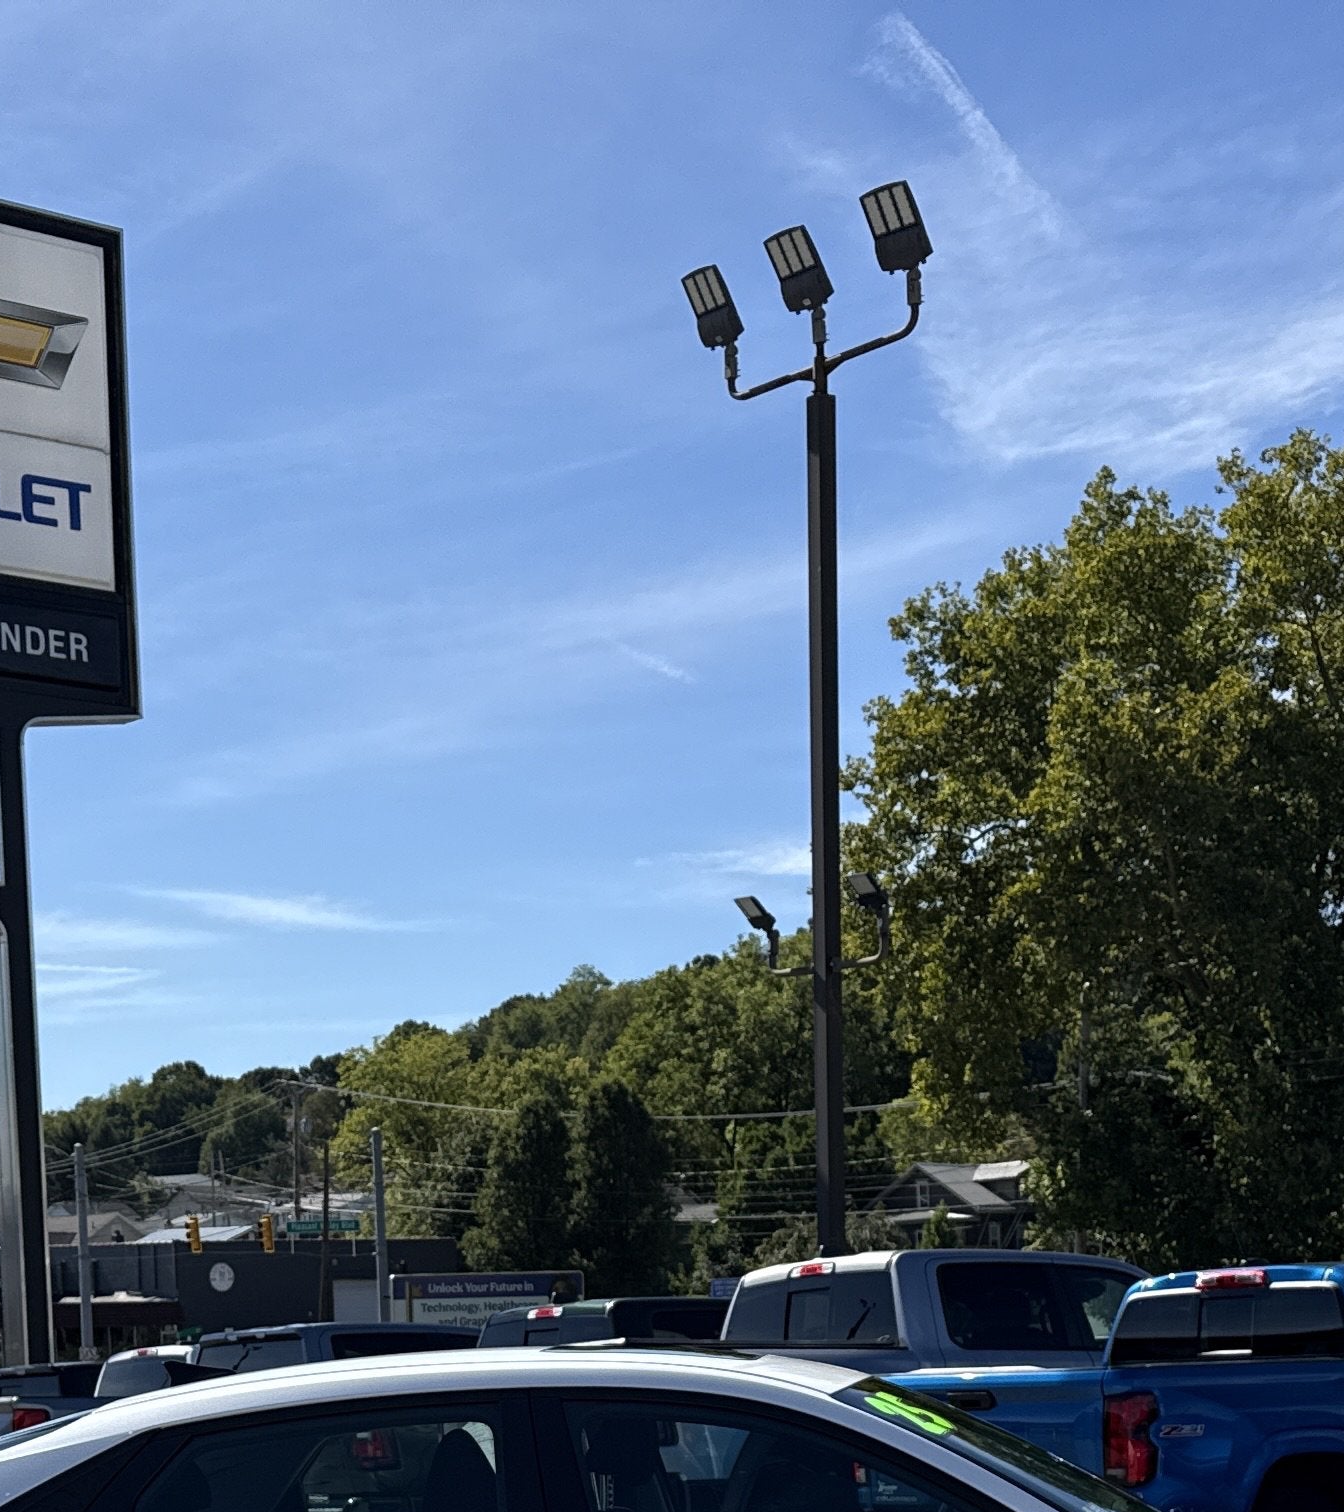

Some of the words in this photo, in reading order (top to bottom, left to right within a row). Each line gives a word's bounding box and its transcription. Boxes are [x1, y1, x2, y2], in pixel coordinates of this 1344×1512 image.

[428, 1282, 463, 1294] Unlock
[465, 1282, 488, 1293] Your
[490, 1281, 523, 1292] Future
[421, 1302, 482, 1315] Technology,
